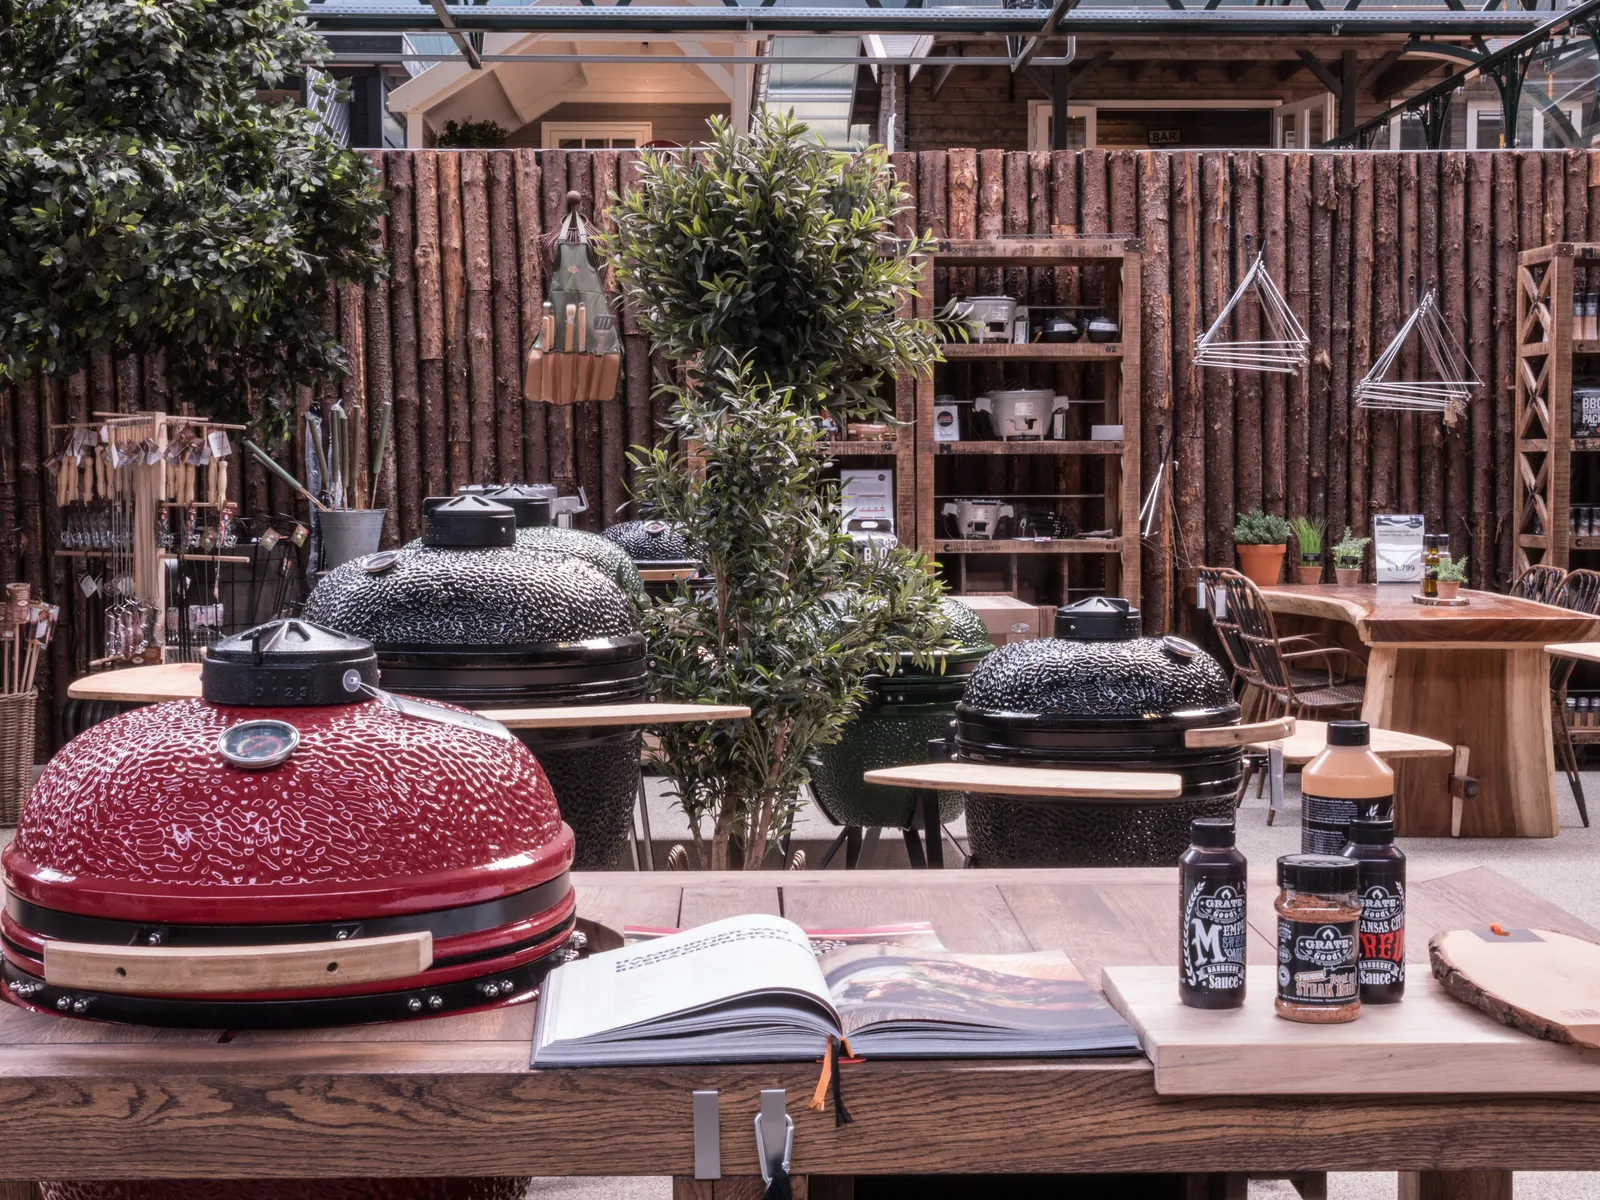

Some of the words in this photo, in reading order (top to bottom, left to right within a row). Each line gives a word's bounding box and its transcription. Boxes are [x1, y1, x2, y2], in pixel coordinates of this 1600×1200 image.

[1152, 131, 1177, 142] BAR
[1395, 564, 1416, 572] 1.799
[1205, 898, 1243, 909] GRATE
[1213, 910, 1238, 919] Goods
[1364, 909, 1390, 919] Goods
[1359, 920, 1390, 933] ANSAS
[1305, 939, 1349, 950] GRATE
[1359, 928, 1404, 962] RED
[1313, 952, 1342, 961] Goods
[1207, 965, 1240, 973] BARBECUE
[1208, 974, 1239, 989] Sauce
[1360, 970, 1392, 985] Sauce
[1295, 981, 1335, 998] STEAK
